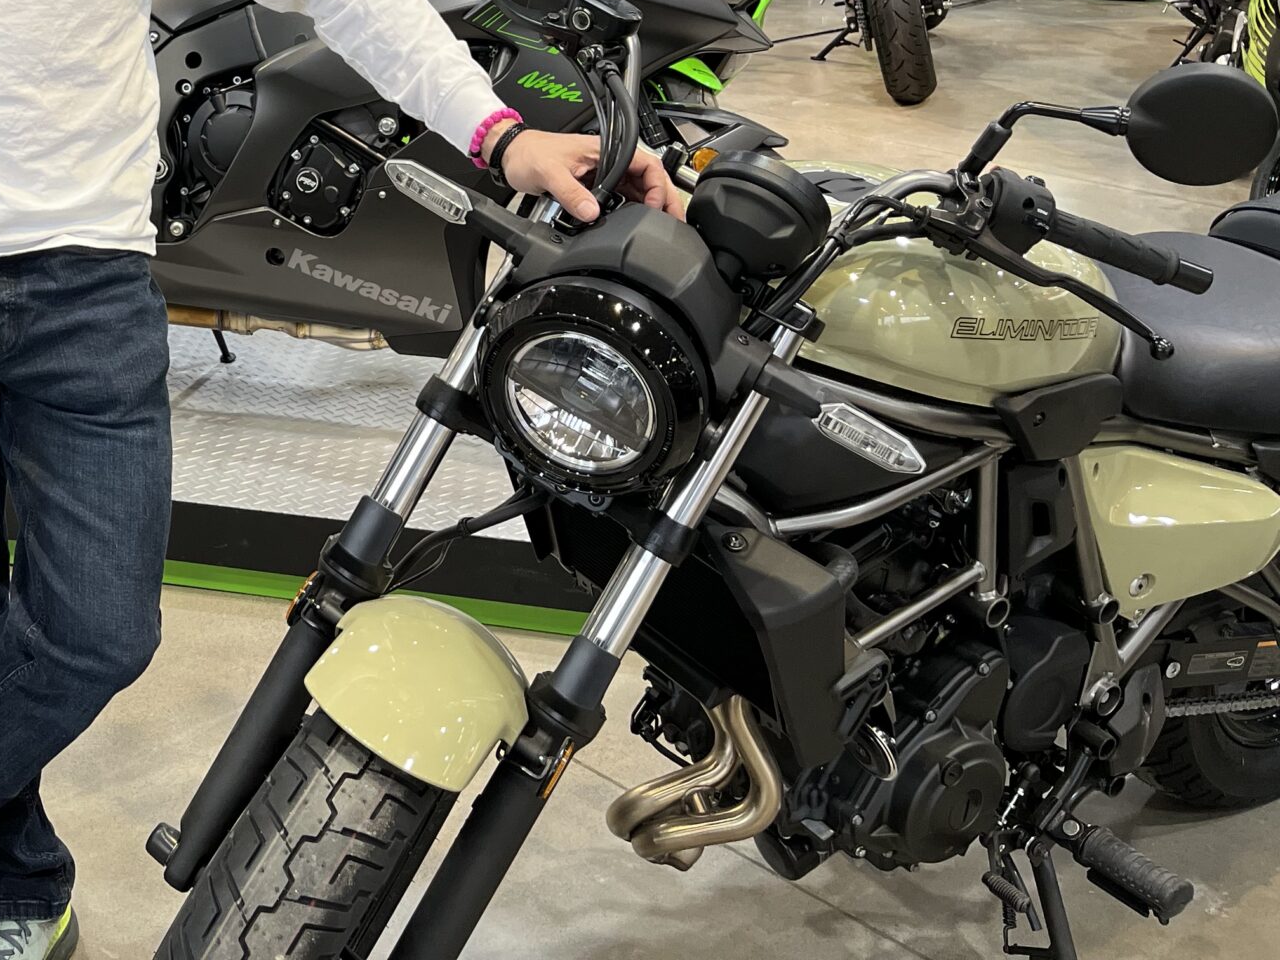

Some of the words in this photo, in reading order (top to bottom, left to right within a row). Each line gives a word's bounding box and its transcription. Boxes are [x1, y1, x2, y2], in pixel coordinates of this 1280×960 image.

[517, 70, 583, 103] Ninja
[288, 248, 453, 325] Kawasaki
[950, 316, 1100, 341] ELIMINATOR
